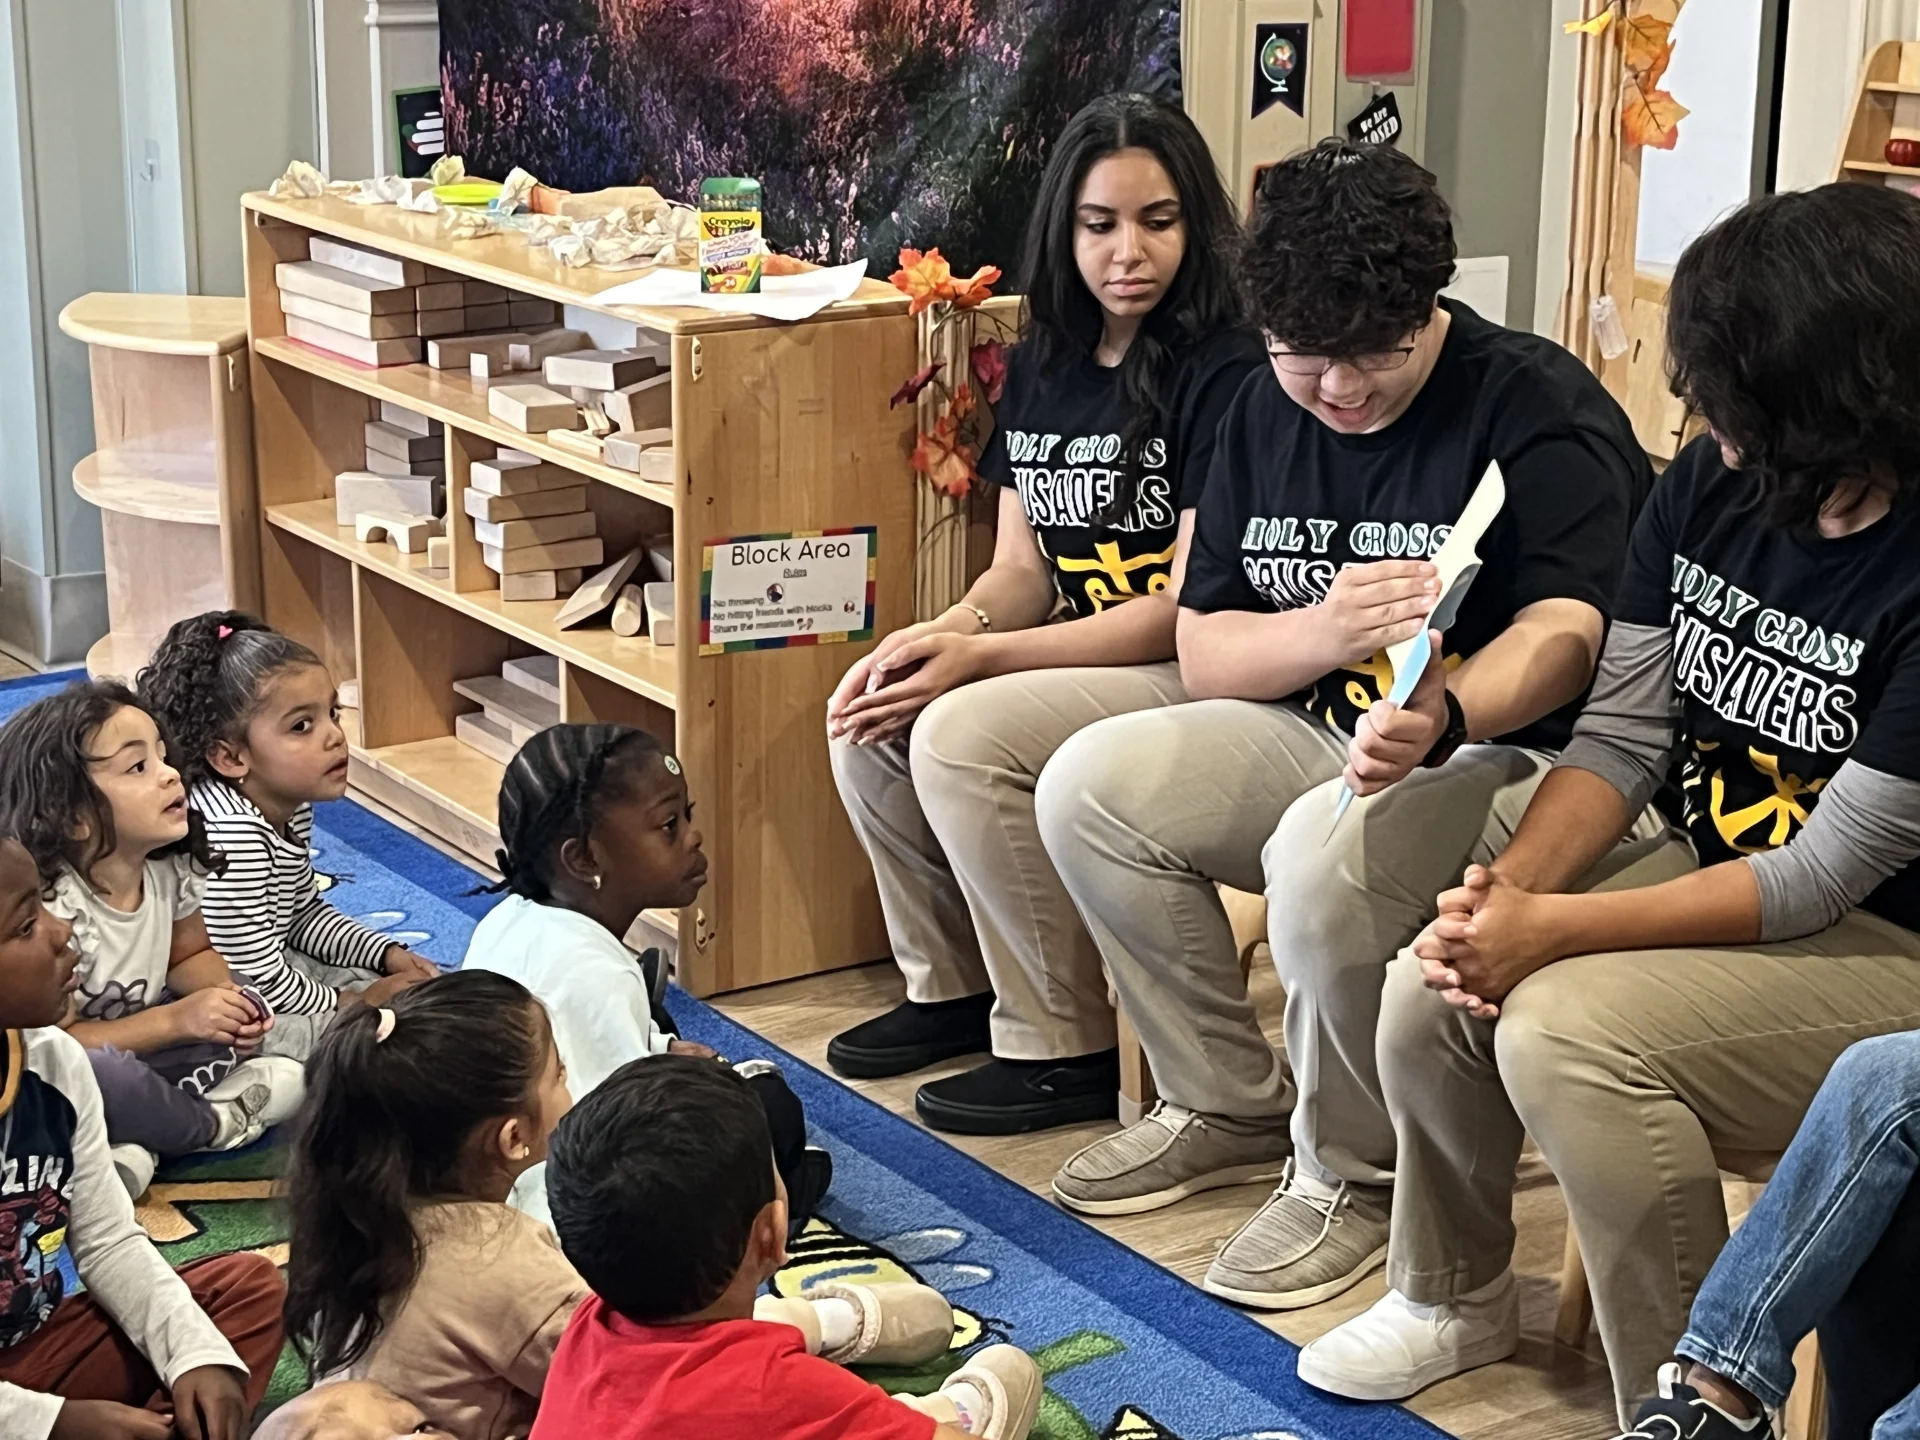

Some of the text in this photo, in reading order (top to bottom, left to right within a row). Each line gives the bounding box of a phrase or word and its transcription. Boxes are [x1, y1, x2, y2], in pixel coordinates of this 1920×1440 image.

[1373, 107, 1387, 125] Are
[1360, 116, 1398, 144] LOSED
[708, 217, 751, 227] Crayola
[1006, 431, 1166, 469] OLY CROS
[1241, 517, 1455, 557] HOLY CROSS
[731, 540, 851, 566] Block Area
[727, 609, 753, 620] hitting
[786, 605, 804, 614] with
[806, 604, 833, 612] blocks
[728, 597, 764, 606] throwing
[1755, 608, 1866, 676] CROSS
